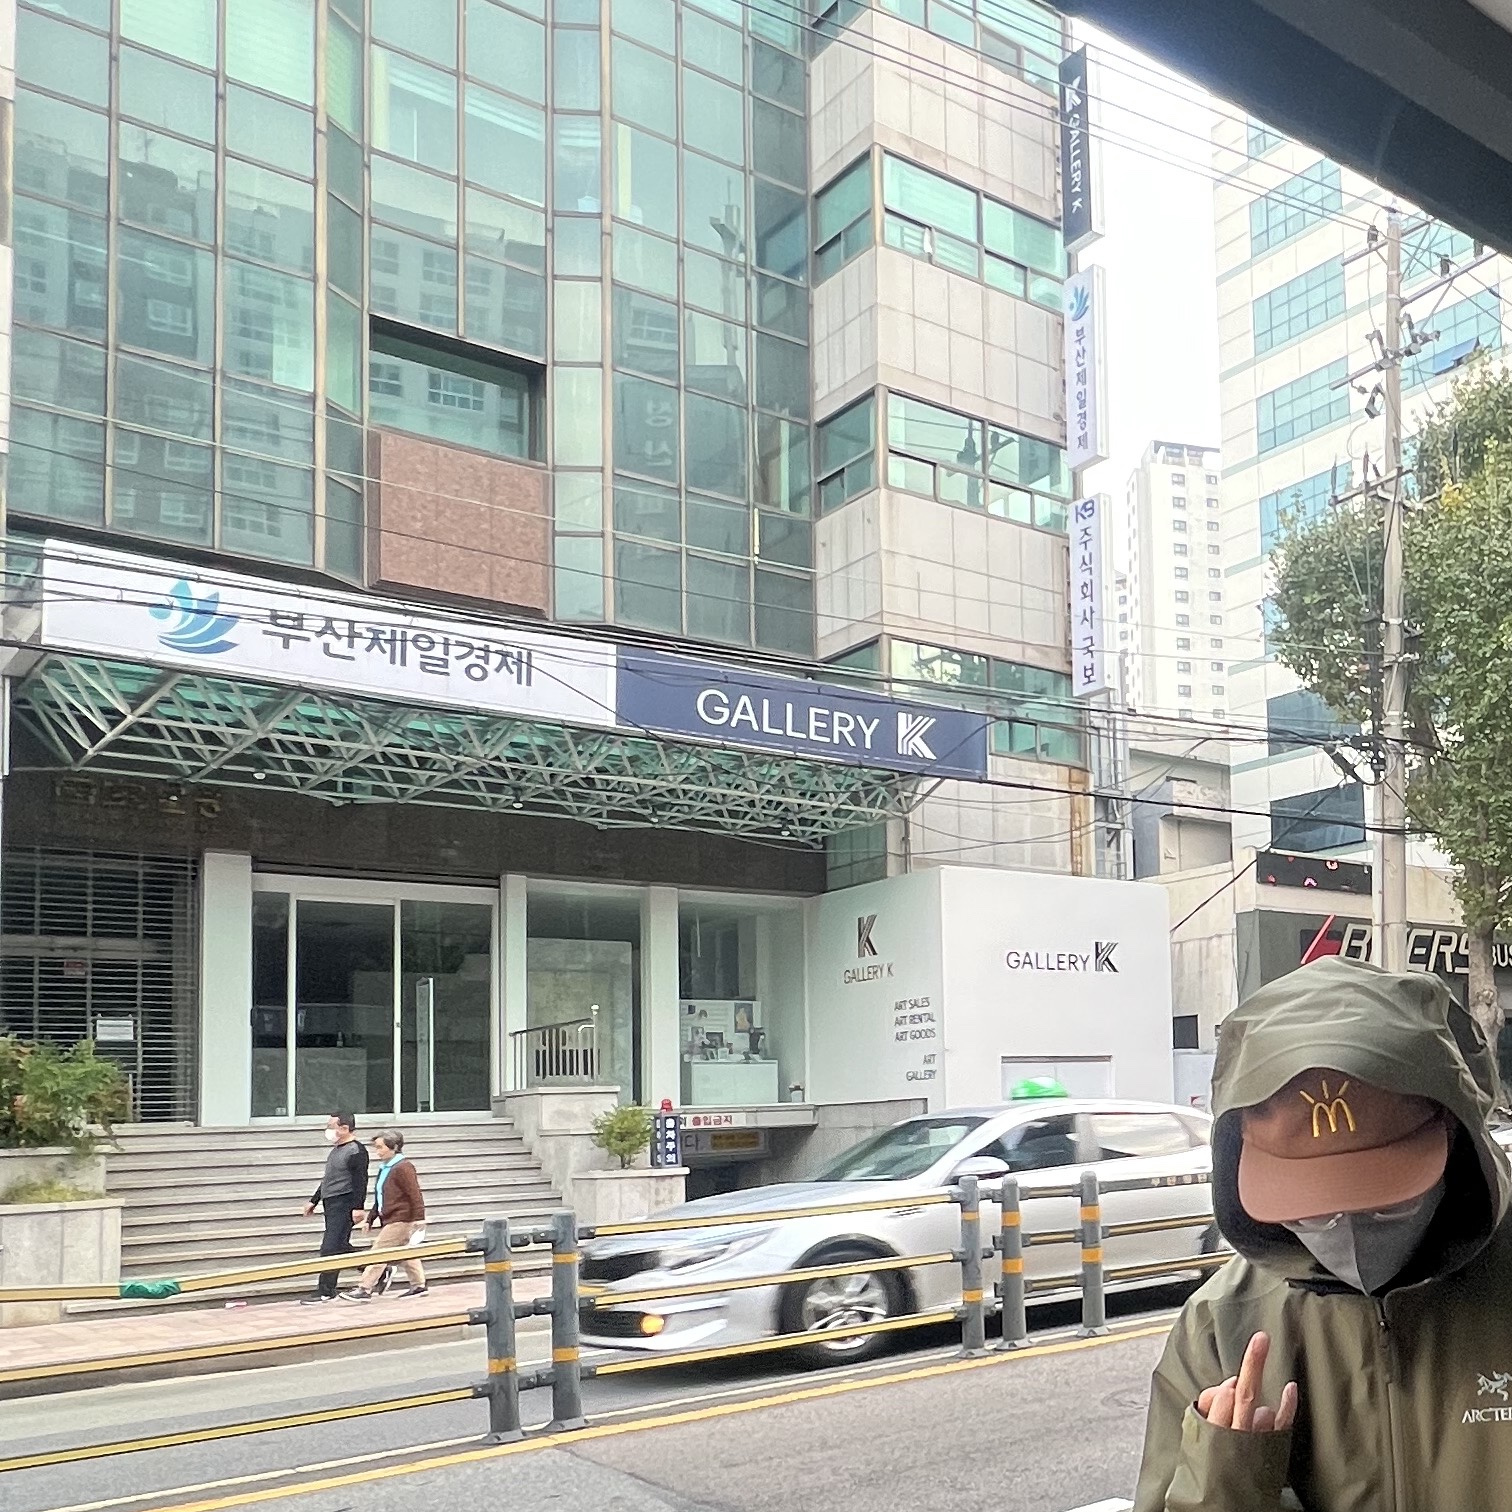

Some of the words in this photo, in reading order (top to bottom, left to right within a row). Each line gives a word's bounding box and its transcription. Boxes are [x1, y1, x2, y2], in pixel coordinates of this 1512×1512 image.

[1068, 113, 1082, 193] GALLERY
[1071, 198, 1083, 213] K
[1074, 326, 1089, 450] 부산제일경제
[1075, 501, 1095, 523] KB
[262, 608, 533, 687] 부산제일경제
[696, 688, 880, 750] GALLERY
[897, 711, 937, 760] K
[1006, 951, 1090, 972] GALLERY
[1094, 941, 1119, 973] K
[843, 964, 885, 984] GALLERY
[886, 962, 894, 978] K
[894, 1000, 907, 1011] ART
[908, 997, 930, 1010] SALES
[894, 1015, 908, 1026] ART
[909, 1012, 936, 1024] RENTAL
[895, 1031, 908, 1041] ART
[910, 1028, 936, 1040] GOODS
[923, 1054, 937, 1065] ART
[906, 1070, 937, 1081] GALLERY
